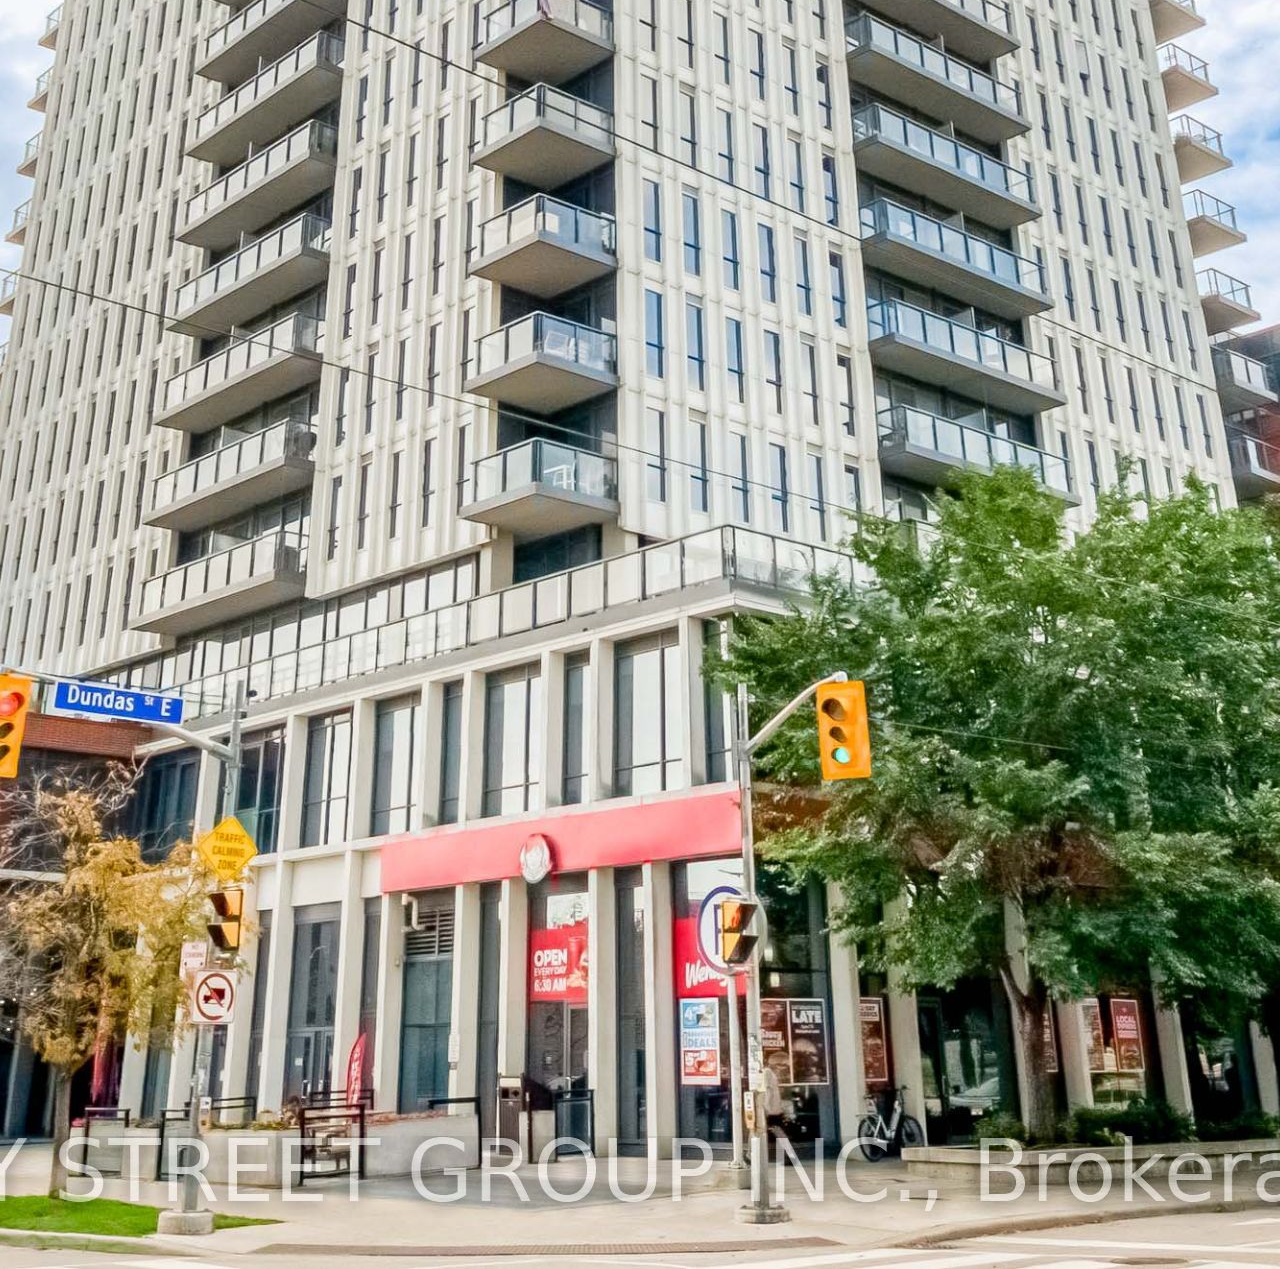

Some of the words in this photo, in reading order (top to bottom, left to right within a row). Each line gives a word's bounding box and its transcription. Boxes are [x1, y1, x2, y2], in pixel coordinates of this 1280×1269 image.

[67, 685, 135, 712] Dundas
[160, 698, 173, 717] E
[215, 832, 245, 845] TRAFFIC
[212, 845, 245, 858] CALMING
[217, 859, 237, 871] ZONE
[534, 948, 568, 968] OPEN
[552, 977, 567, 992] AM
[792, 1010, 822, 1024] LATE
